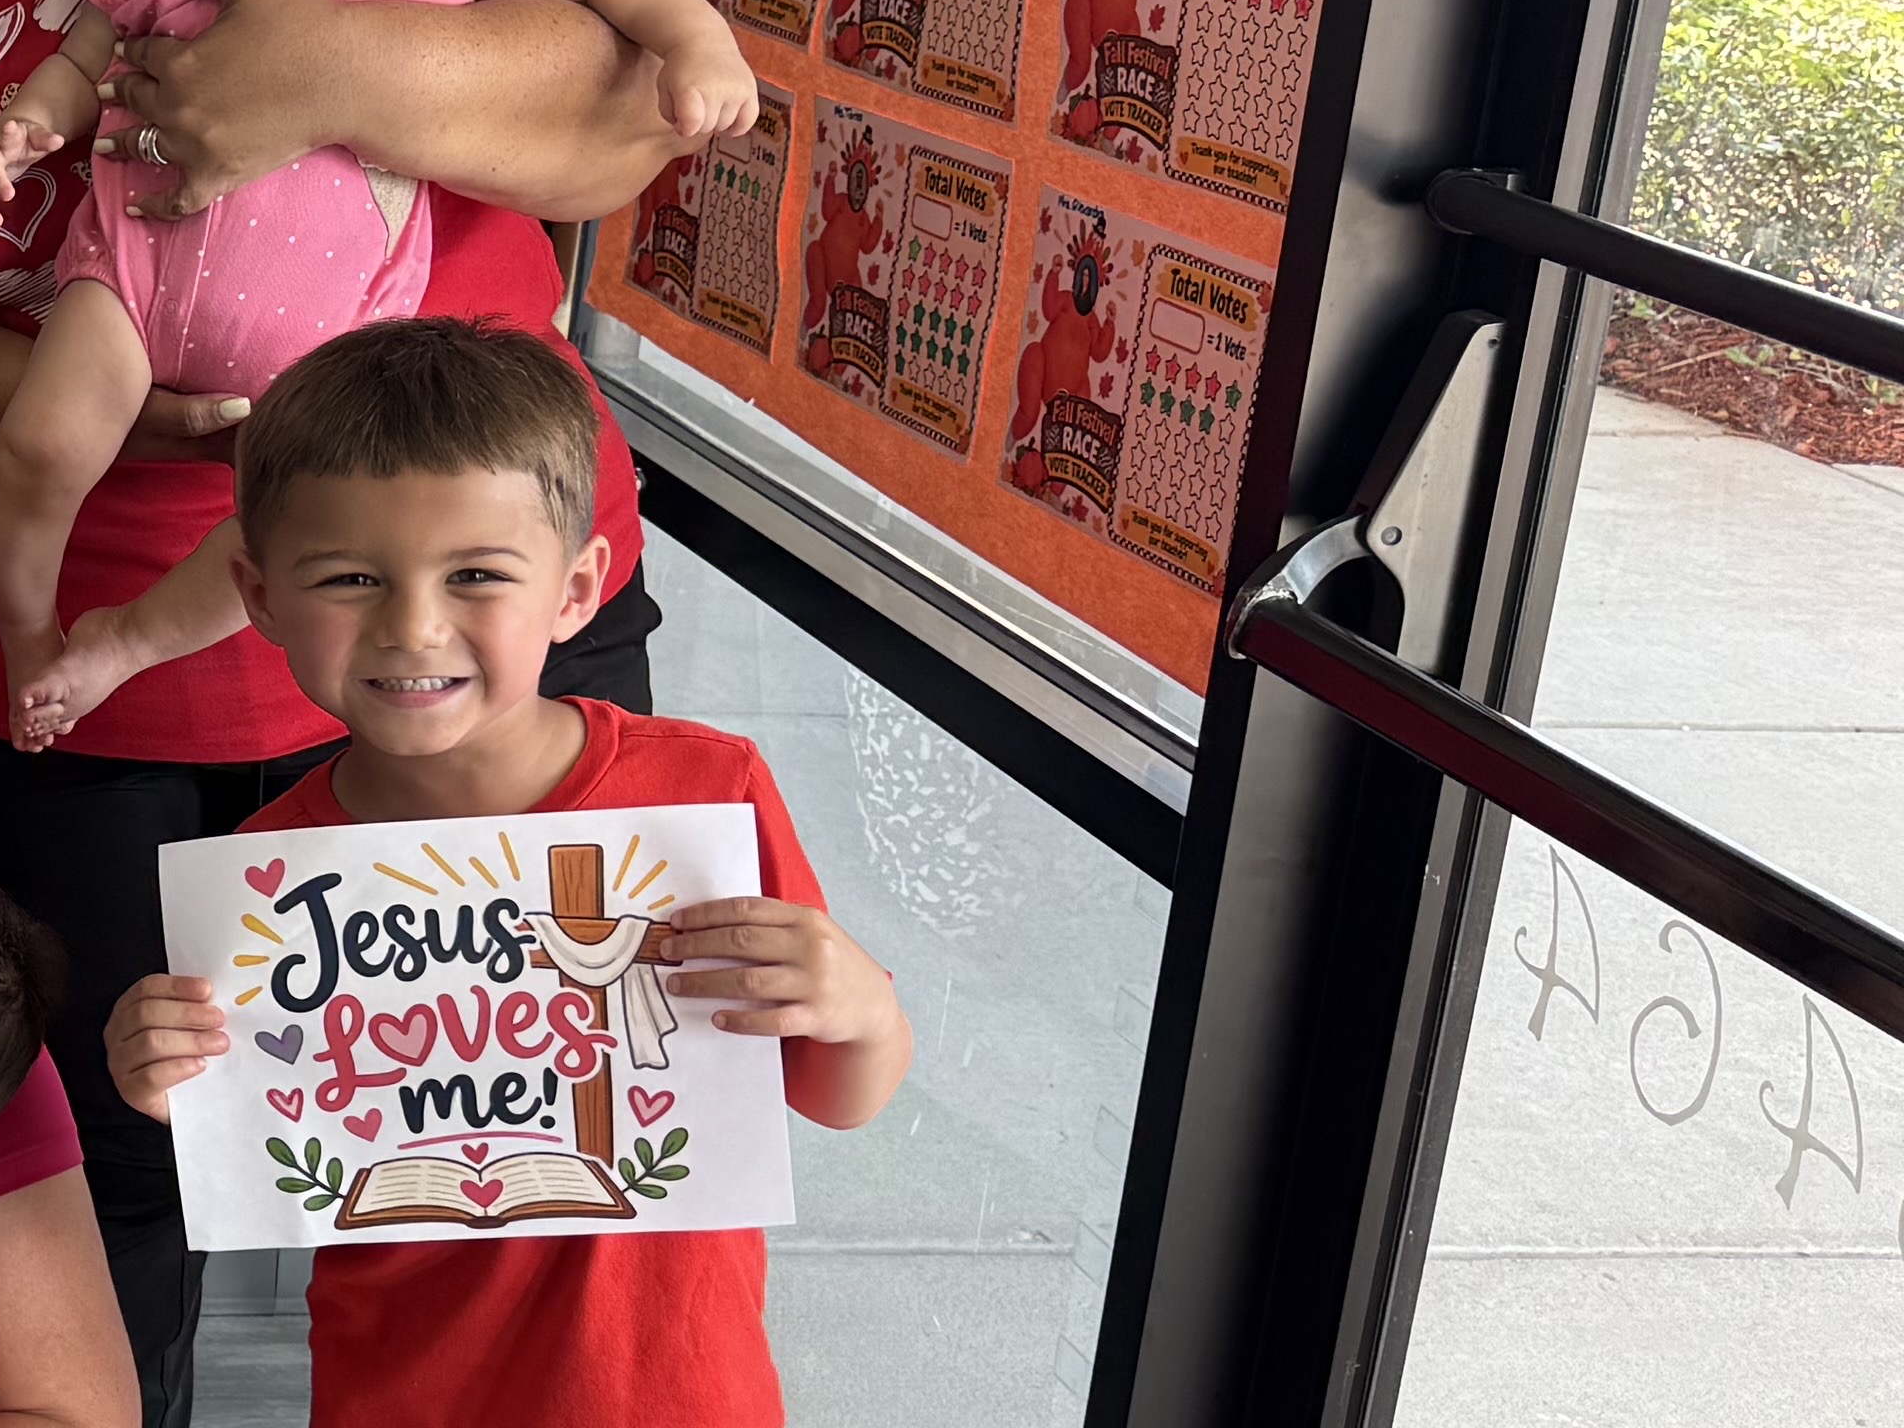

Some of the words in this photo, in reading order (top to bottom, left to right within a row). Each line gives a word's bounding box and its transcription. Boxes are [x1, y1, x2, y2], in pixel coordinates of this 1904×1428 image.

[1116, 66, 1155, 102] RACE
[1103, 99, 1126, 121] VOTE
[924, 166, 952, 197] Total
[956, 176, 988, 212] Votes
[1170, 268, 1206, 306] Total
[1210, 284, 1250, 325] Votes
[1062, 428, 1100, 463] RACE
[1048, 457, 1070, 479] VOTE
[270, 872, 538, 1013] Jesus
[398, 1067, 558, 1134] me!
